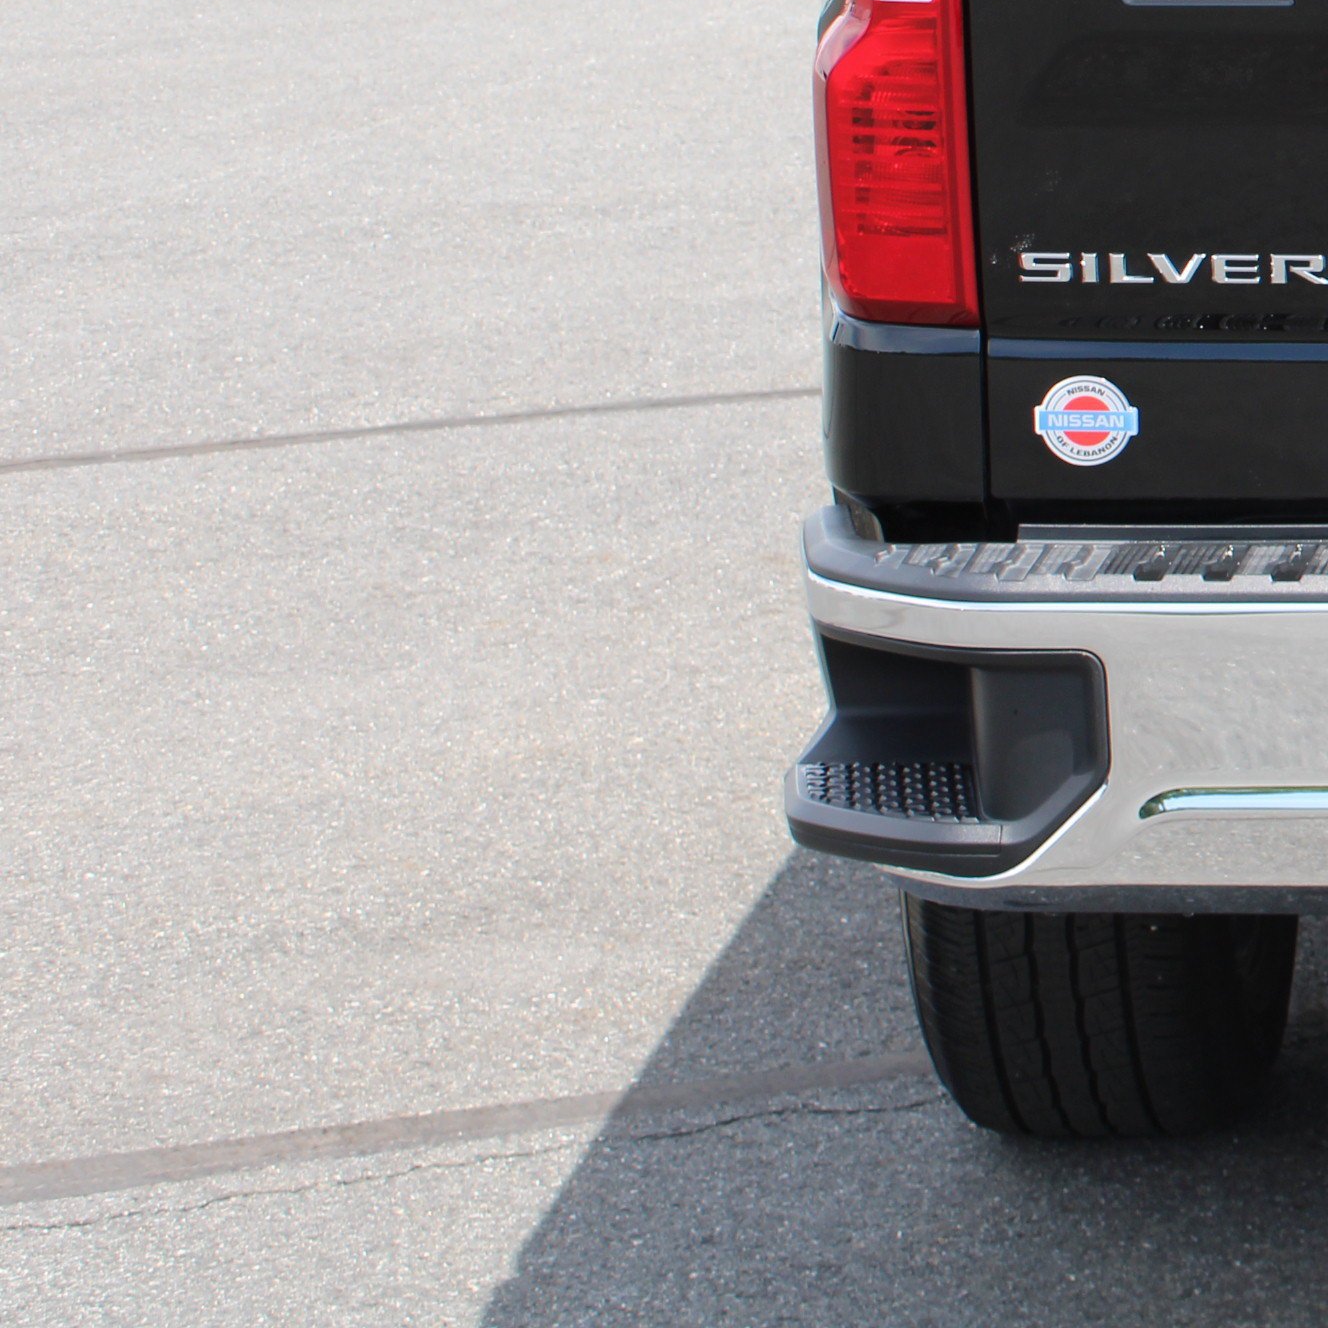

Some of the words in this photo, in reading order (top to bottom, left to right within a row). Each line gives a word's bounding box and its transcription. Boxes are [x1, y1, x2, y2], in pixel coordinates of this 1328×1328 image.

[1066, 385, 1106, 397] NISSAN
[1047, 413, 1125, 428] NISSAN
[1056, 435, 1069, 449] OF
[1069, 436, 1118, 457] LEBANON
